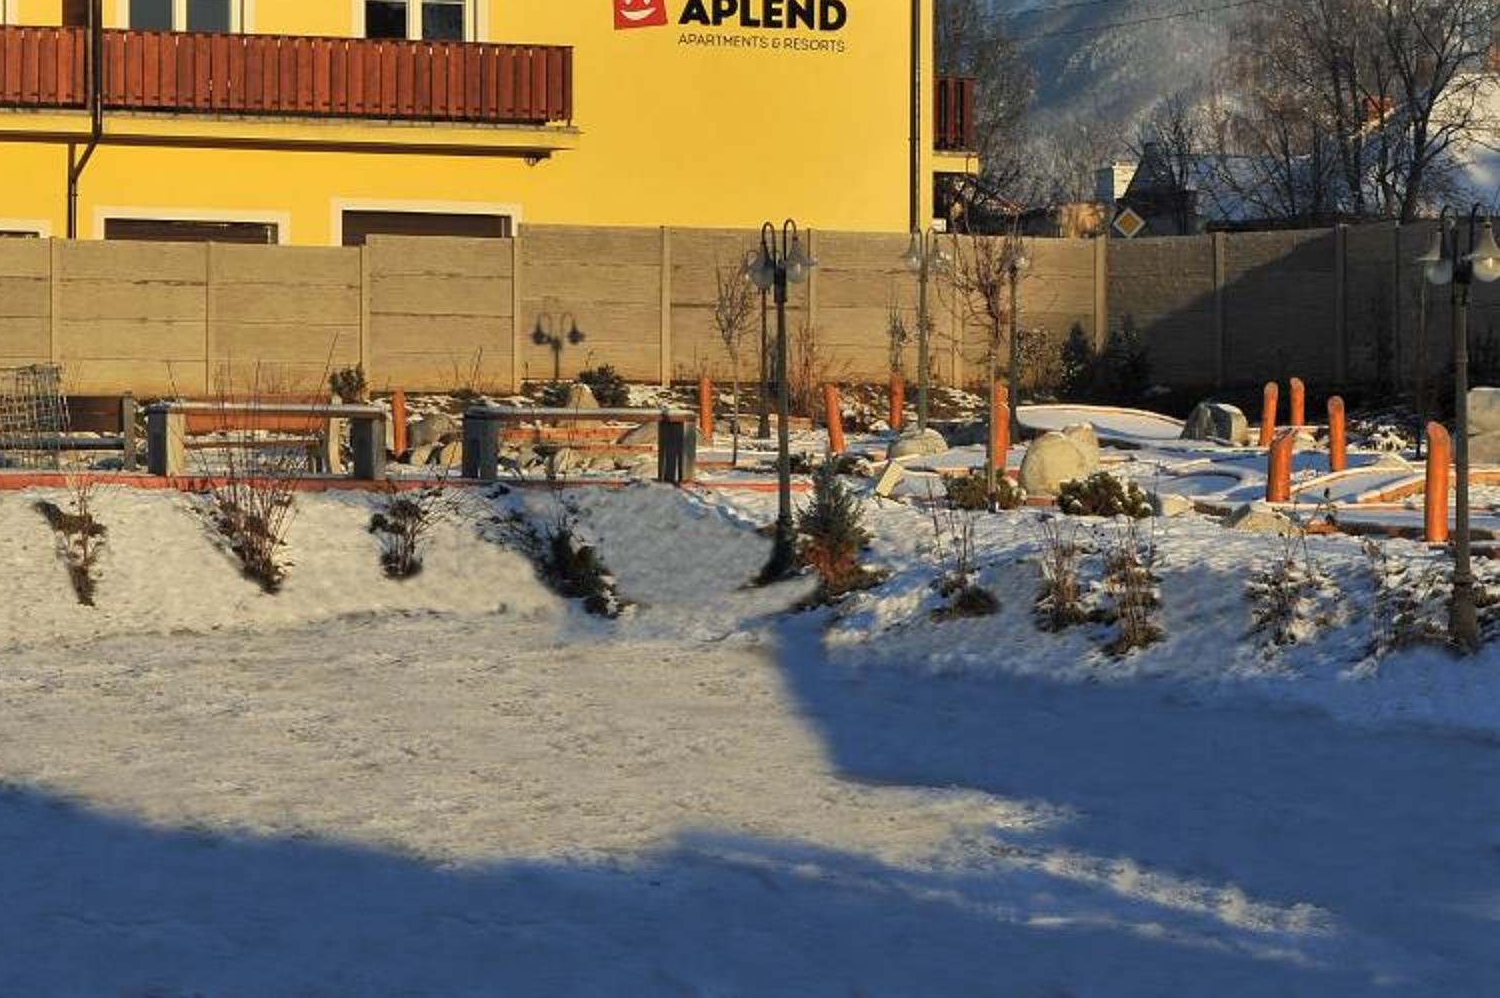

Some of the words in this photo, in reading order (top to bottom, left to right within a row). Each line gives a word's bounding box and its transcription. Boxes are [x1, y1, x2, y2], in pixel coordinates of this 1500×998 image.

[678, 33, 768, 49] APARTMENTS
[771, 38, 781, 49] &
[783, 37, 845, 52] RESORTS
